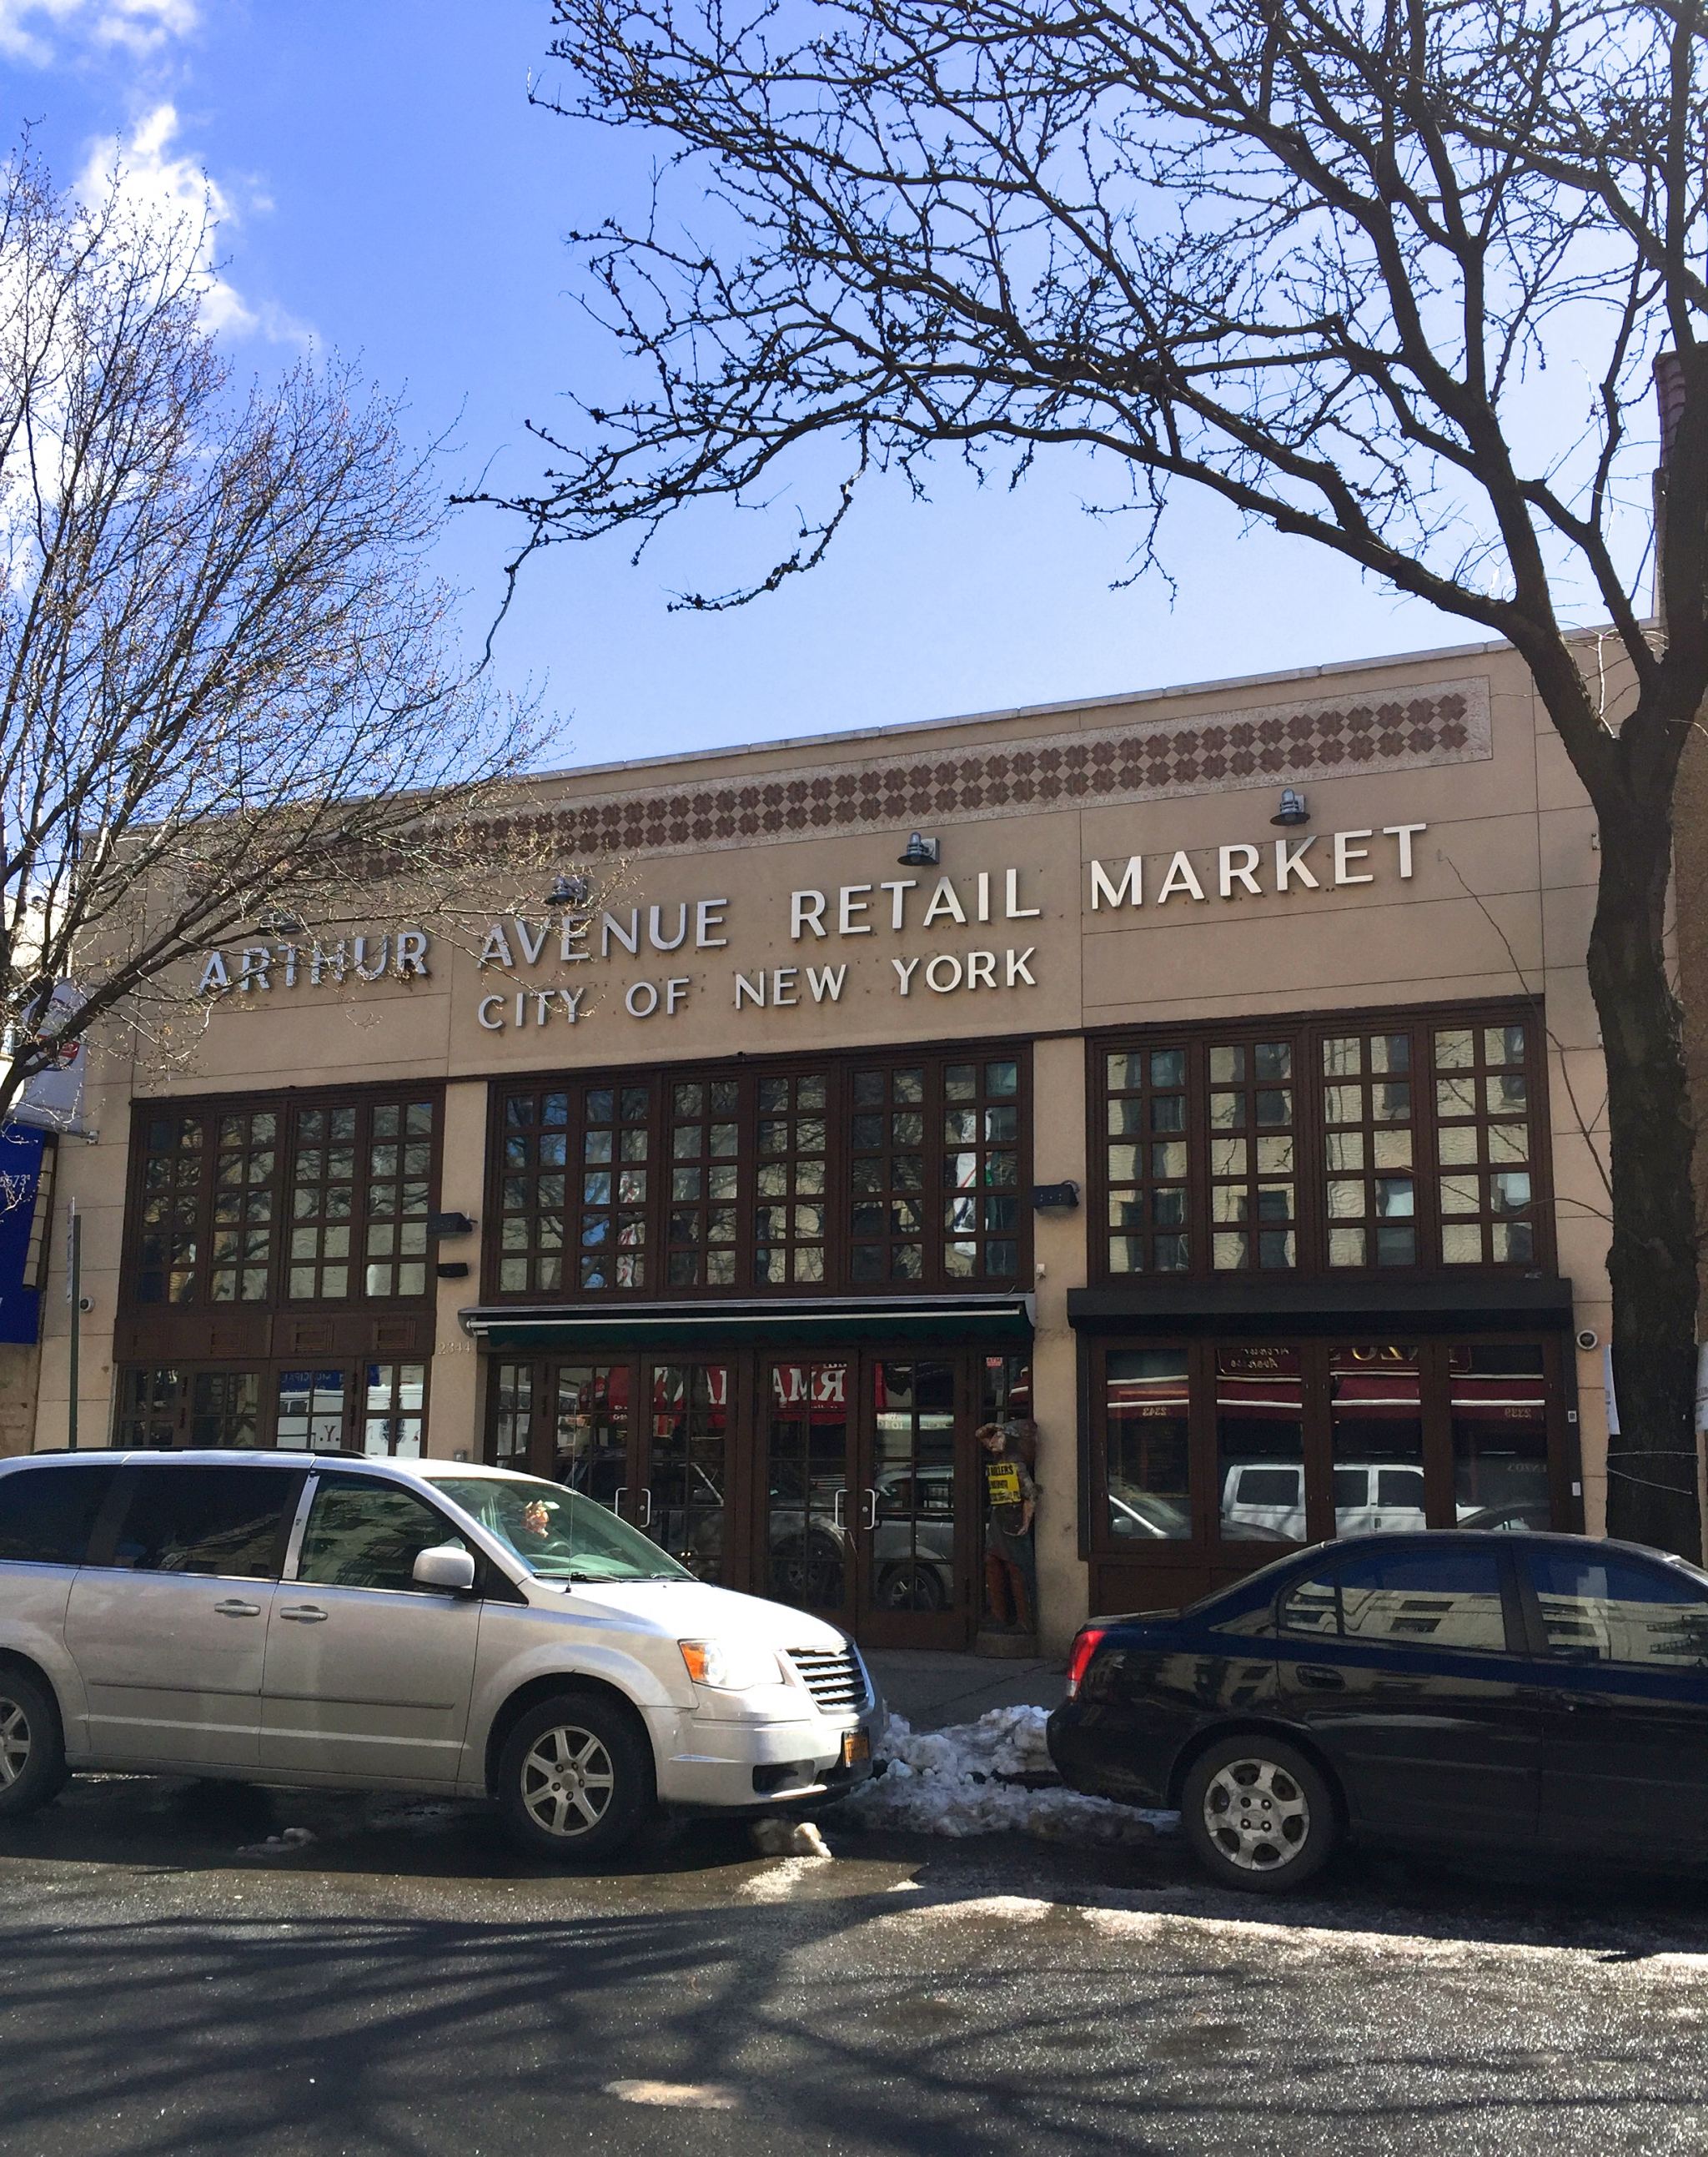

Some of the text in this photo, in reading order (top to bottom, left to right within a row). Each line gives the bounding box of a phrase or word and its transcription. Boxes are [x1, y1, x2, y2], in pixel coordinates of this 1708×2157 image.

[198, 823, 1427, 994] ARTHUR AVENUE RETAIL MARKET
[477, 947, 1037, 1030] CITY OF NEW YORK
[438, 1340, 472, 1355] 2344
